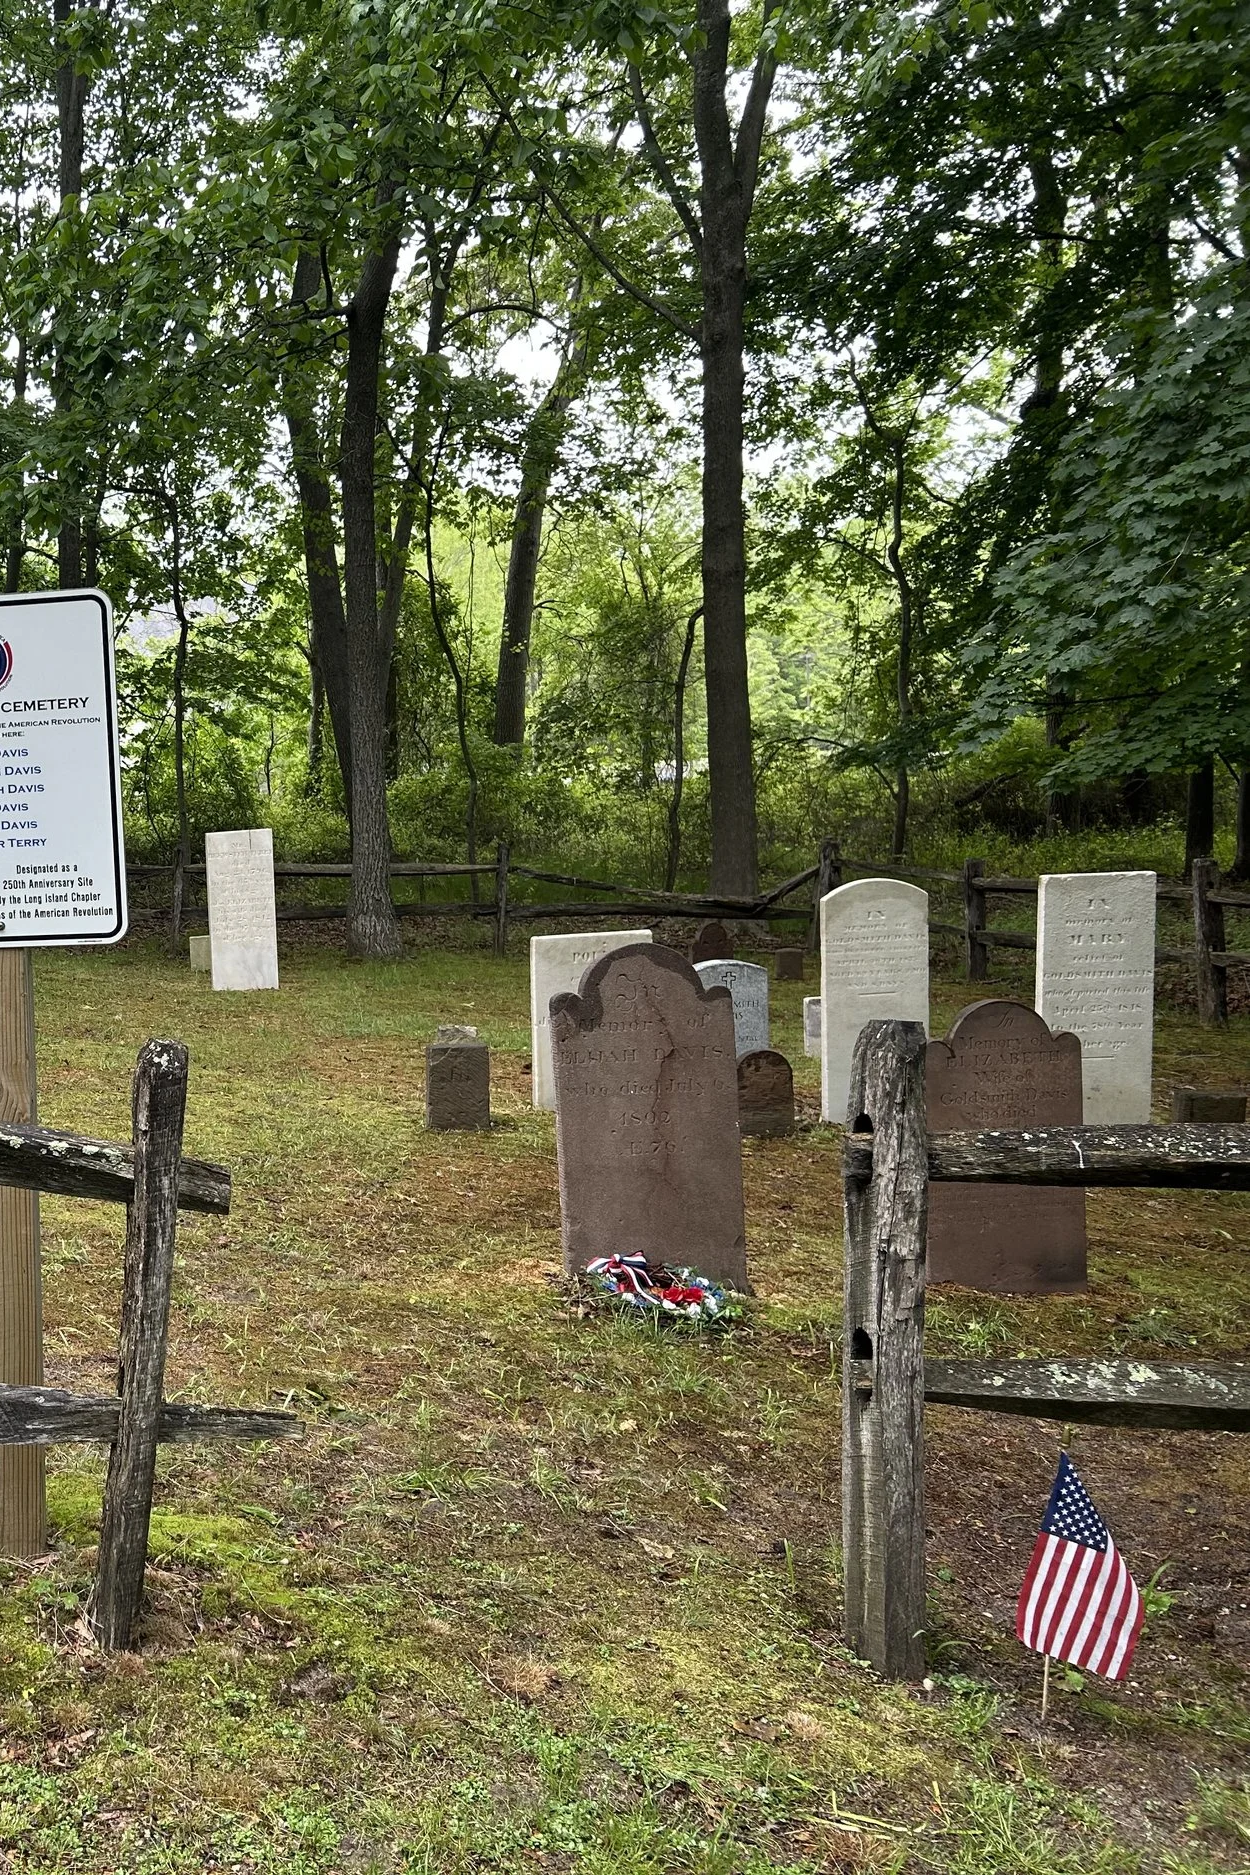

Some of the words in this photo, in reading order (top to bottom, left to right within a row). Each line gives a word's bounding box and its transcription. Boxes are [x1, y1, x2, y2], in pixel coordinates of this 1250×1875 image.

[0, 696, 89, 713] CEMETERY
[8, 720, 49, 728] AMERICAN
[51, 717, 101, 725] REVOLUTION
[4, 766, 42, 776] DAVIS
[8, 784, 45, 794] DAVIS
[1, 820, 38, 830] DAVIS
[7, 838, 47, 848] TERRY
[16, 863, 58, 875] Designated
[61, 864, 70, 873] as
[73, 864, 78, 872] a
[2, 880, 26, 890] 250th
[28, 879, 75, 889] Anniversary
[77, 877, 93, 887] Site
[9, 895, 21, 905] the
[24, 894, 42, 904] Long
[45, 892, 68, 903] Island
[71, 892, 101, 903] Chapter
[8, 909, 16, 919] of
[19, 909, 31, 919] the
[34, 908, 70, 918] American
[72, 906, 113, 917] Revolution
[1068, 933, 1128, 946] MARY
[686, 1012, 711, 1029] of
[956, 1035, 1021, 1051] Memory
[1030, 1032, 1048, 1046] of
[559, 1048, 639, 1065] ELIJAH
[945, 1050, 1062, 1068] ELIZABETH
[973, 1069, 1011, 1084] Wife
[1015, 1068, 1033, 1083] of
[565, 1082, 609, 1098] who
[619, 1079, 661, 1096] died
[665, 1077, 706, 1096] July
[940, 1088, 1019, 1106] Goldsmith
[1025, 1087, 1068, 1101] Davis
[618, 1110, 672, 1127] 1802
[964, 1107, 999, 1120] who
[1002, 1104, 1037, 1119] died
